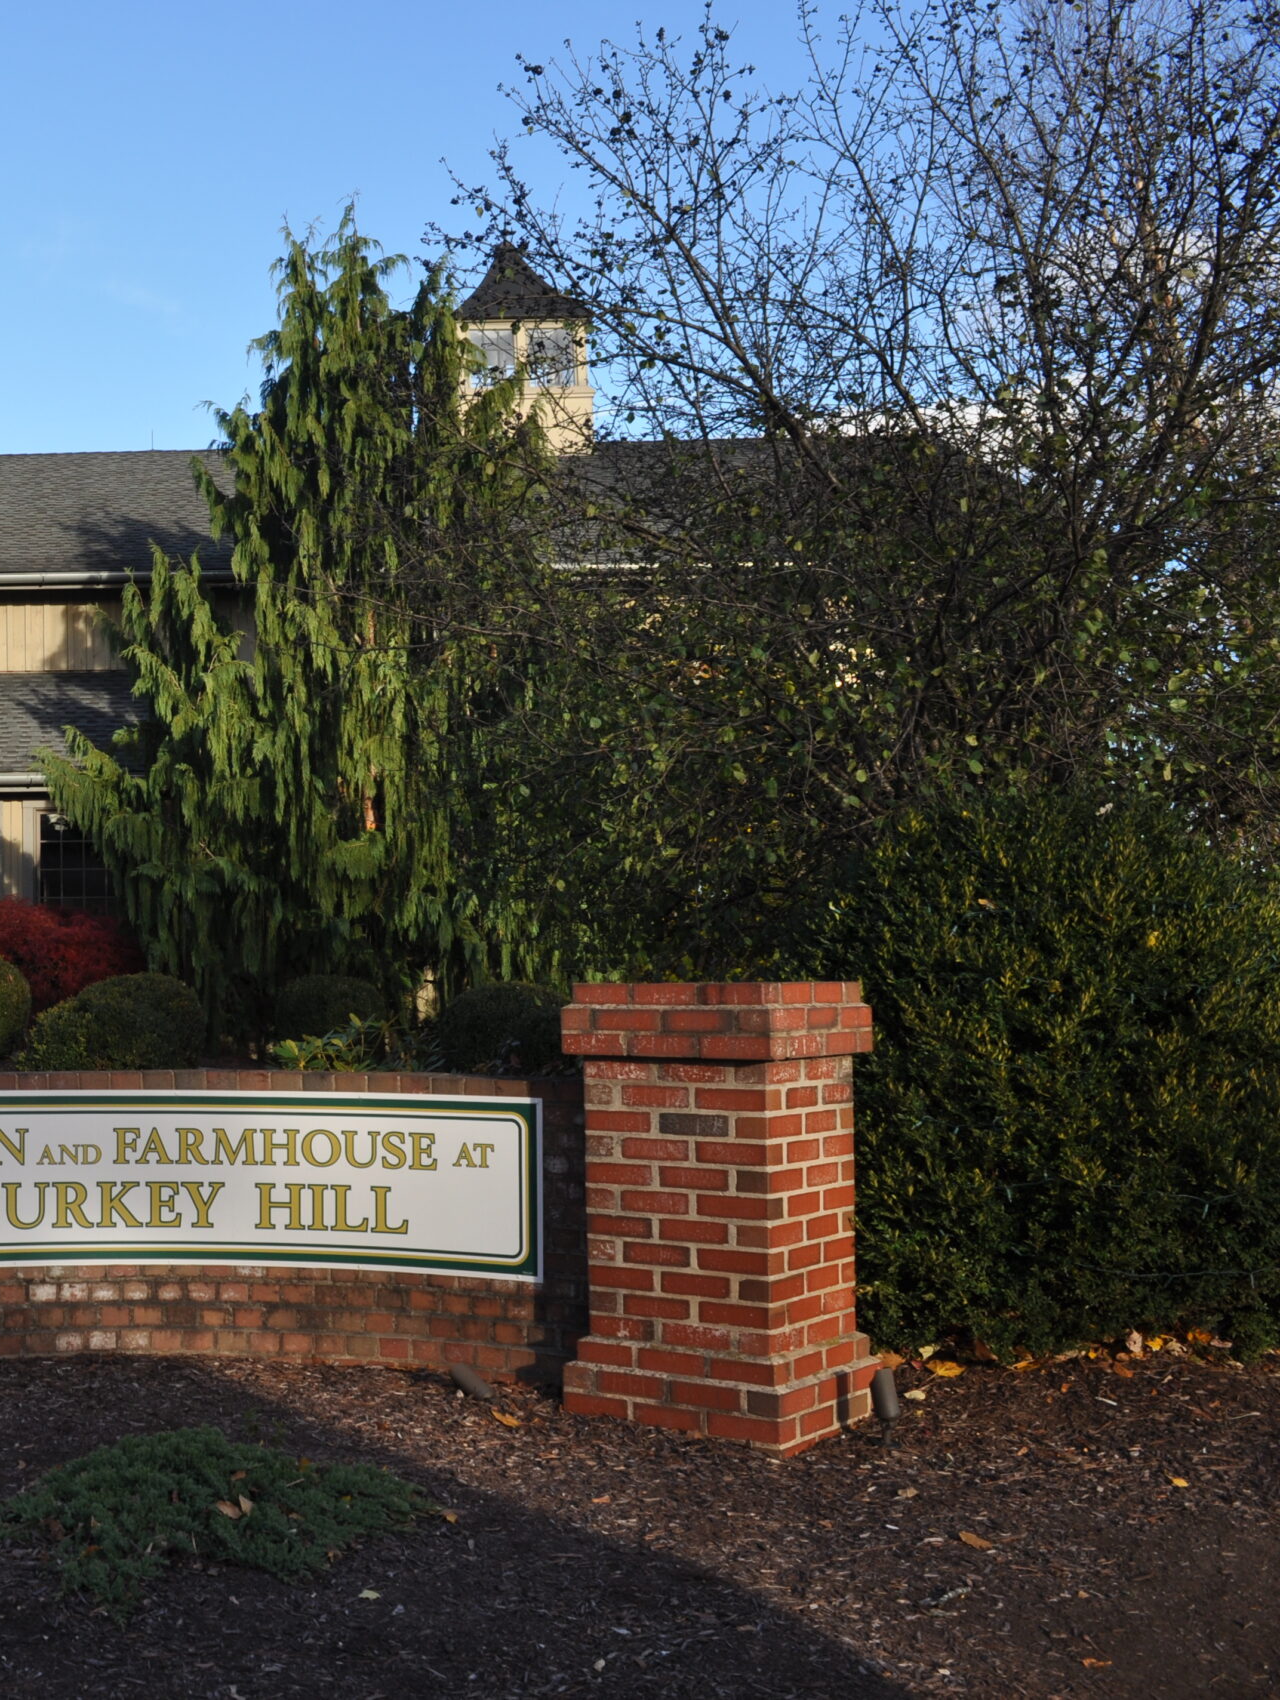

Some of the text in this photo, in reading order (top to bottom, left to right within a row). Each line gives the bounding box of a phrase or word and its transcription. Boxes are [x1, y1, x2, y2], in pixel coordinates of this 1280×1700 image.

[36, 1144, 102, 1165] AND
[113, 1127, 438, 1171] FARMHOUSE
[452, 1142, 495, 1168] AT
[254, 1183, 409, 1235] HILL
